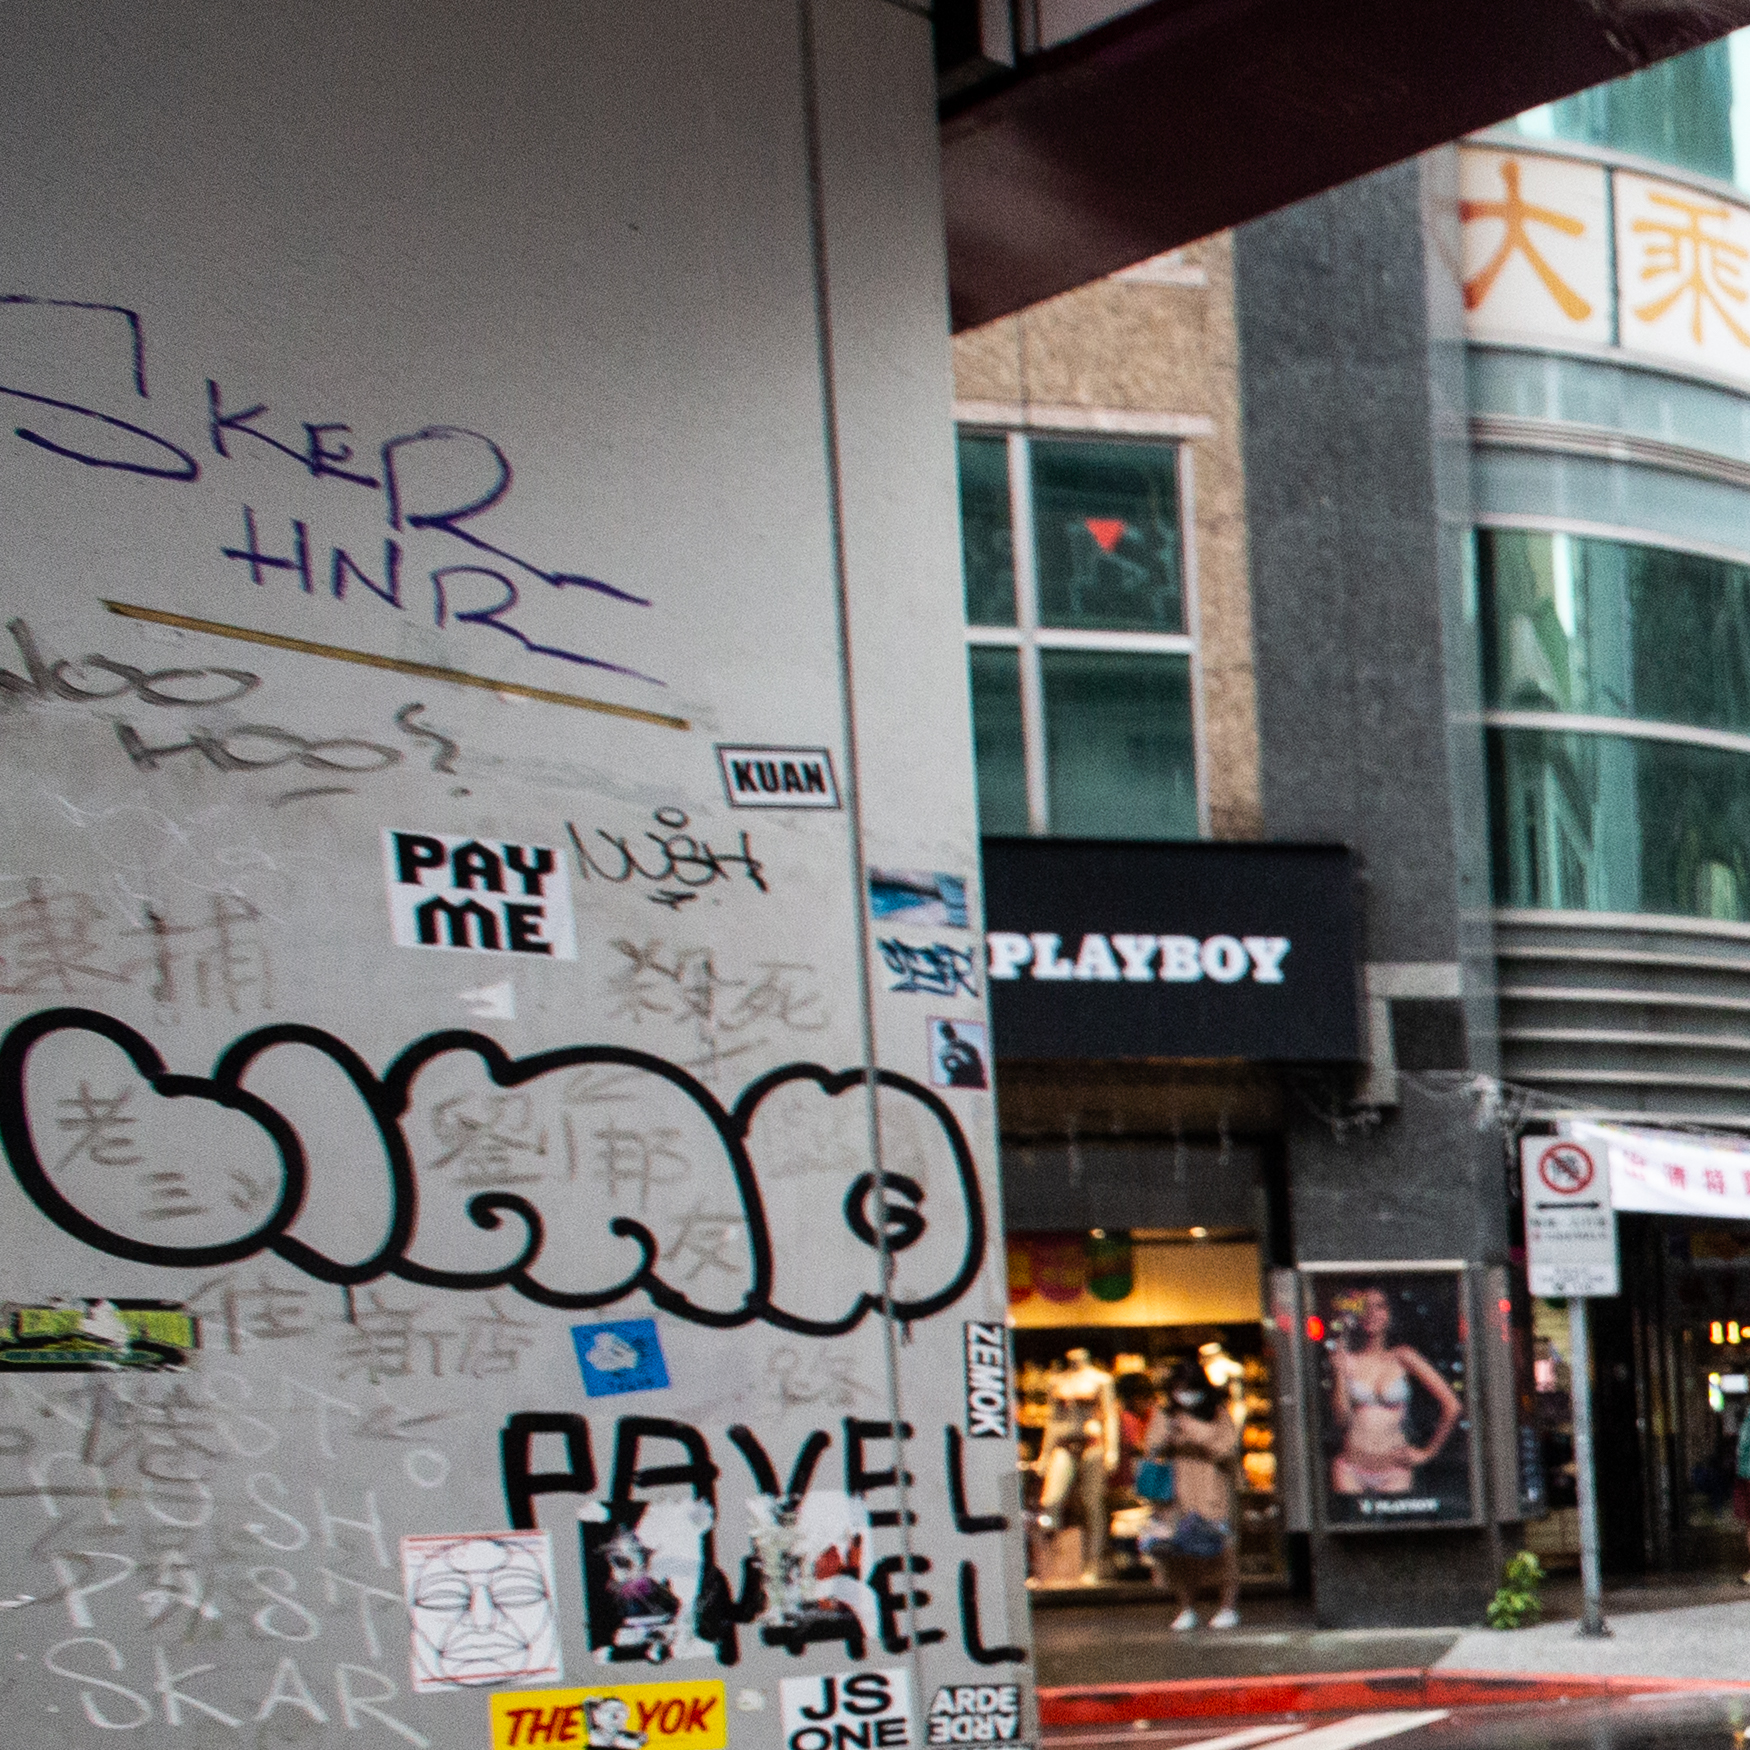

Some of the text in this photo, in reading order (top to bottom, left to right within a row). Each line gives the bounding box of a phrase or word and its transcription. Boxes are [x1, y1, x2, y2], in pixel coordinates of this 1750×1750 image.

[732, 761, 825, 796] KUAN
[391, 831, 558, 898] PAY
[414, 896, 554, 954] ME
[986, 931, 1291, 984] PLAYBOY
[969, 1322, 1007, 1438] ZEMOK
[506, 1696, 718, 1746] THE YOK
[804, 1673, 892, 1721] JS
[932, 1686, 1018, 1714] ARDE
